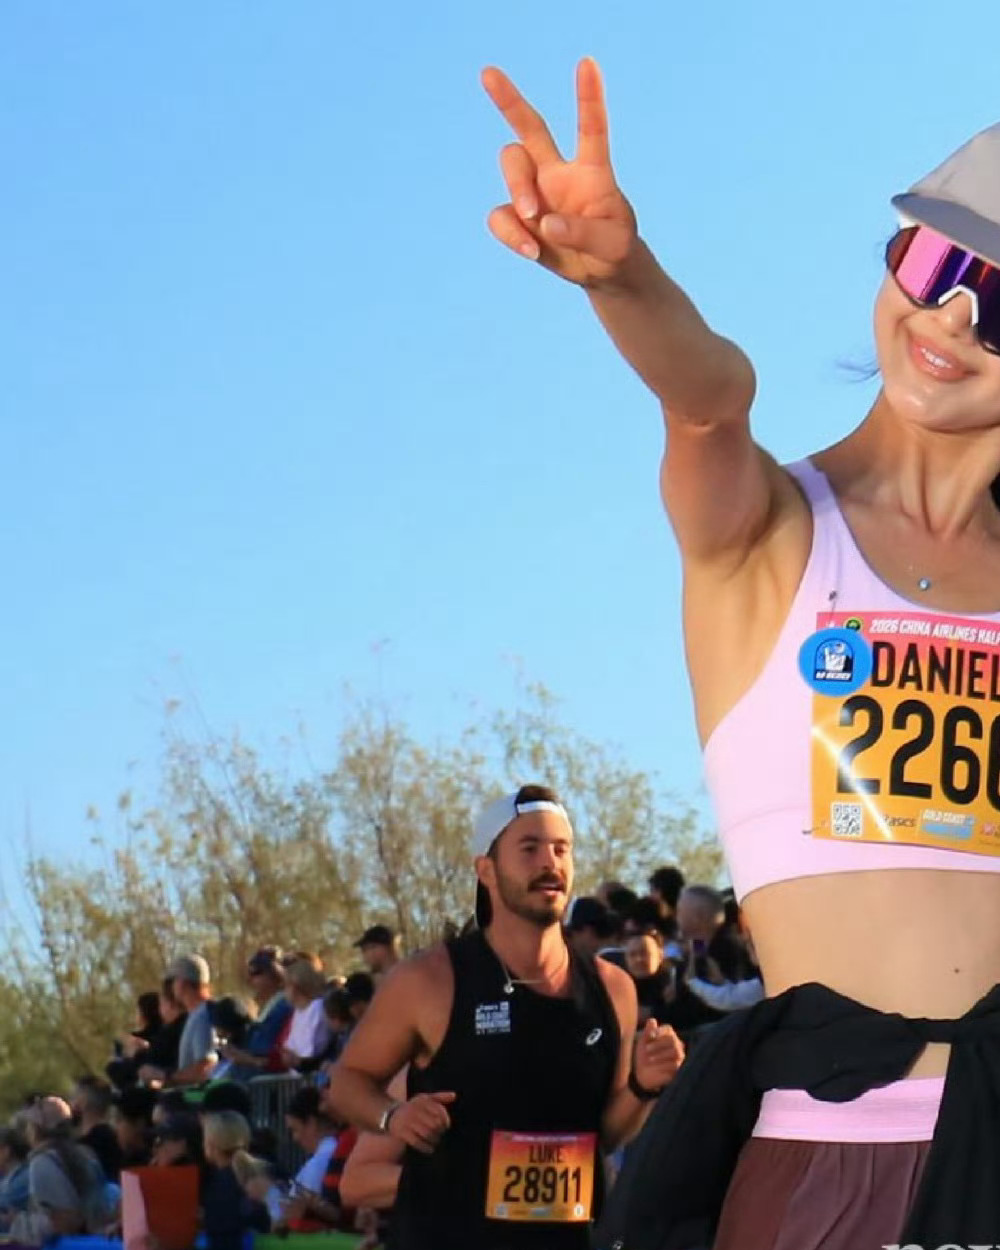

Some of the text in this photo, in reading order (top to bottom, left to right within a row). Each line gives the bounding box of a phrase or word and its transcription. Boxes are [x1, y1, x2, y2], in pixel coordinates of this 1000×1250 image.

[900, 620, 931, 636] CHINA
[932, 623, 977, 643] AIRLINES
[529, 1144, 564, 1164] LUKE
[503, 1165, 582, 1204] 28911
